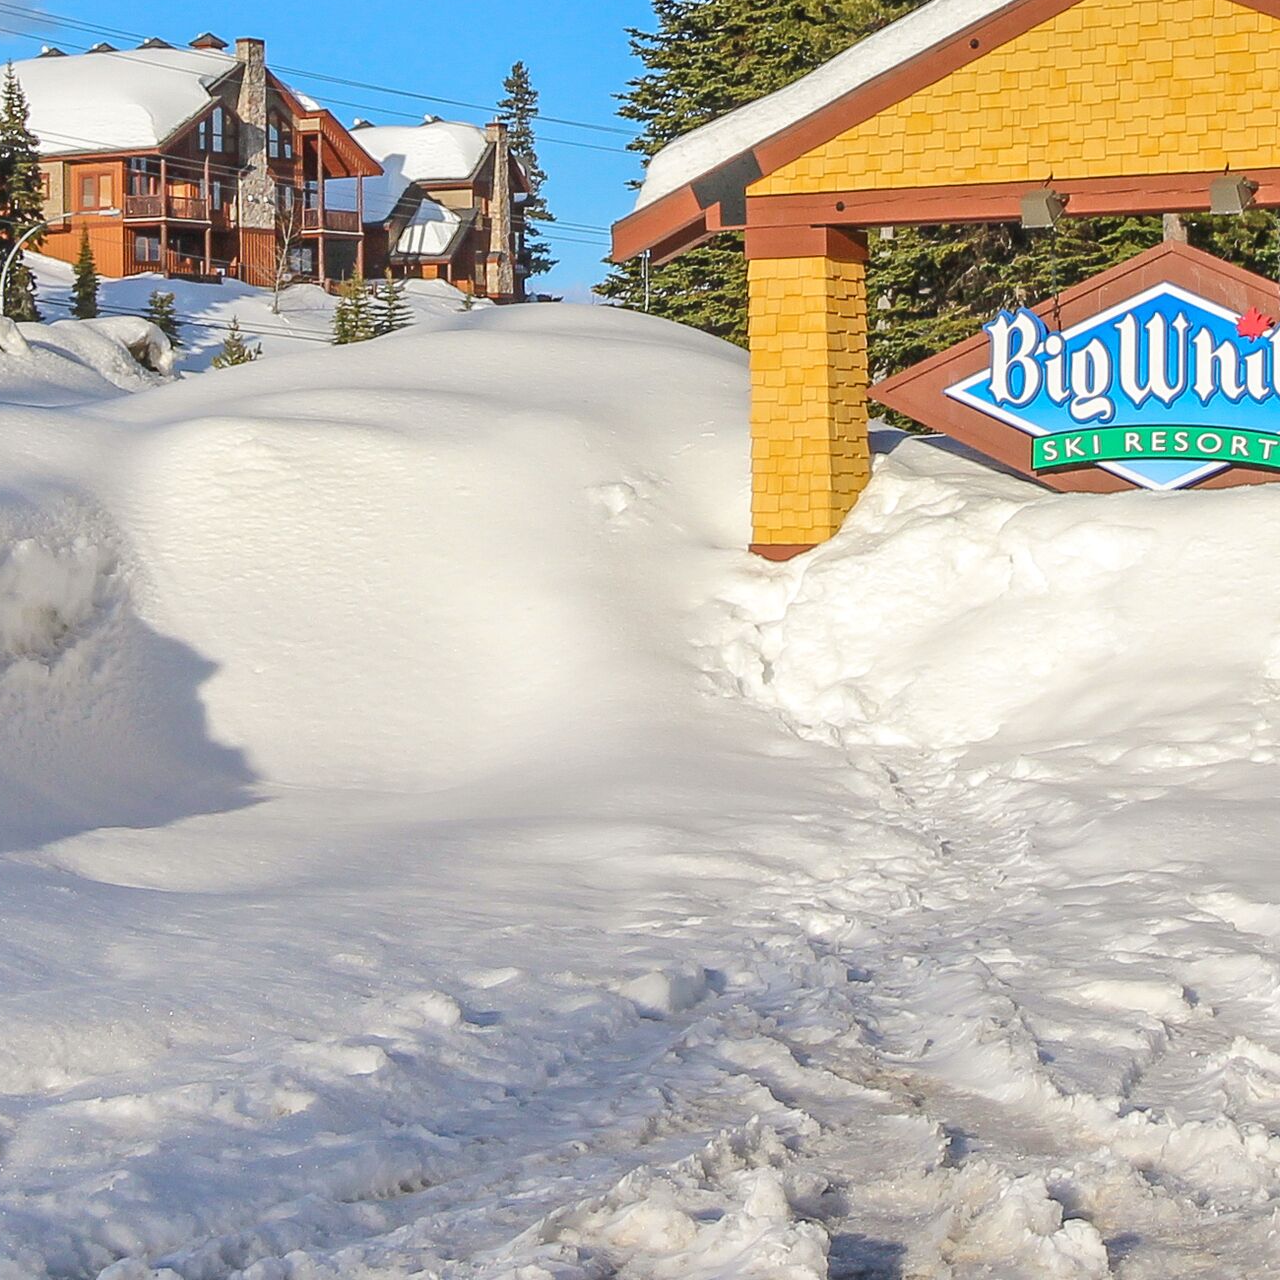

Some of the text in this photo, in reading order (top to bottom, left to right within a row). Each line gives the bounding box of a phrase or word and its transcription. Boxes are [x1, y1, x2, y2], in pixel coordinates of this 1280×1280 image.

[986, 310, 1115, 421] Big
[1042, 431, 1279, 462] SKI RESORT
